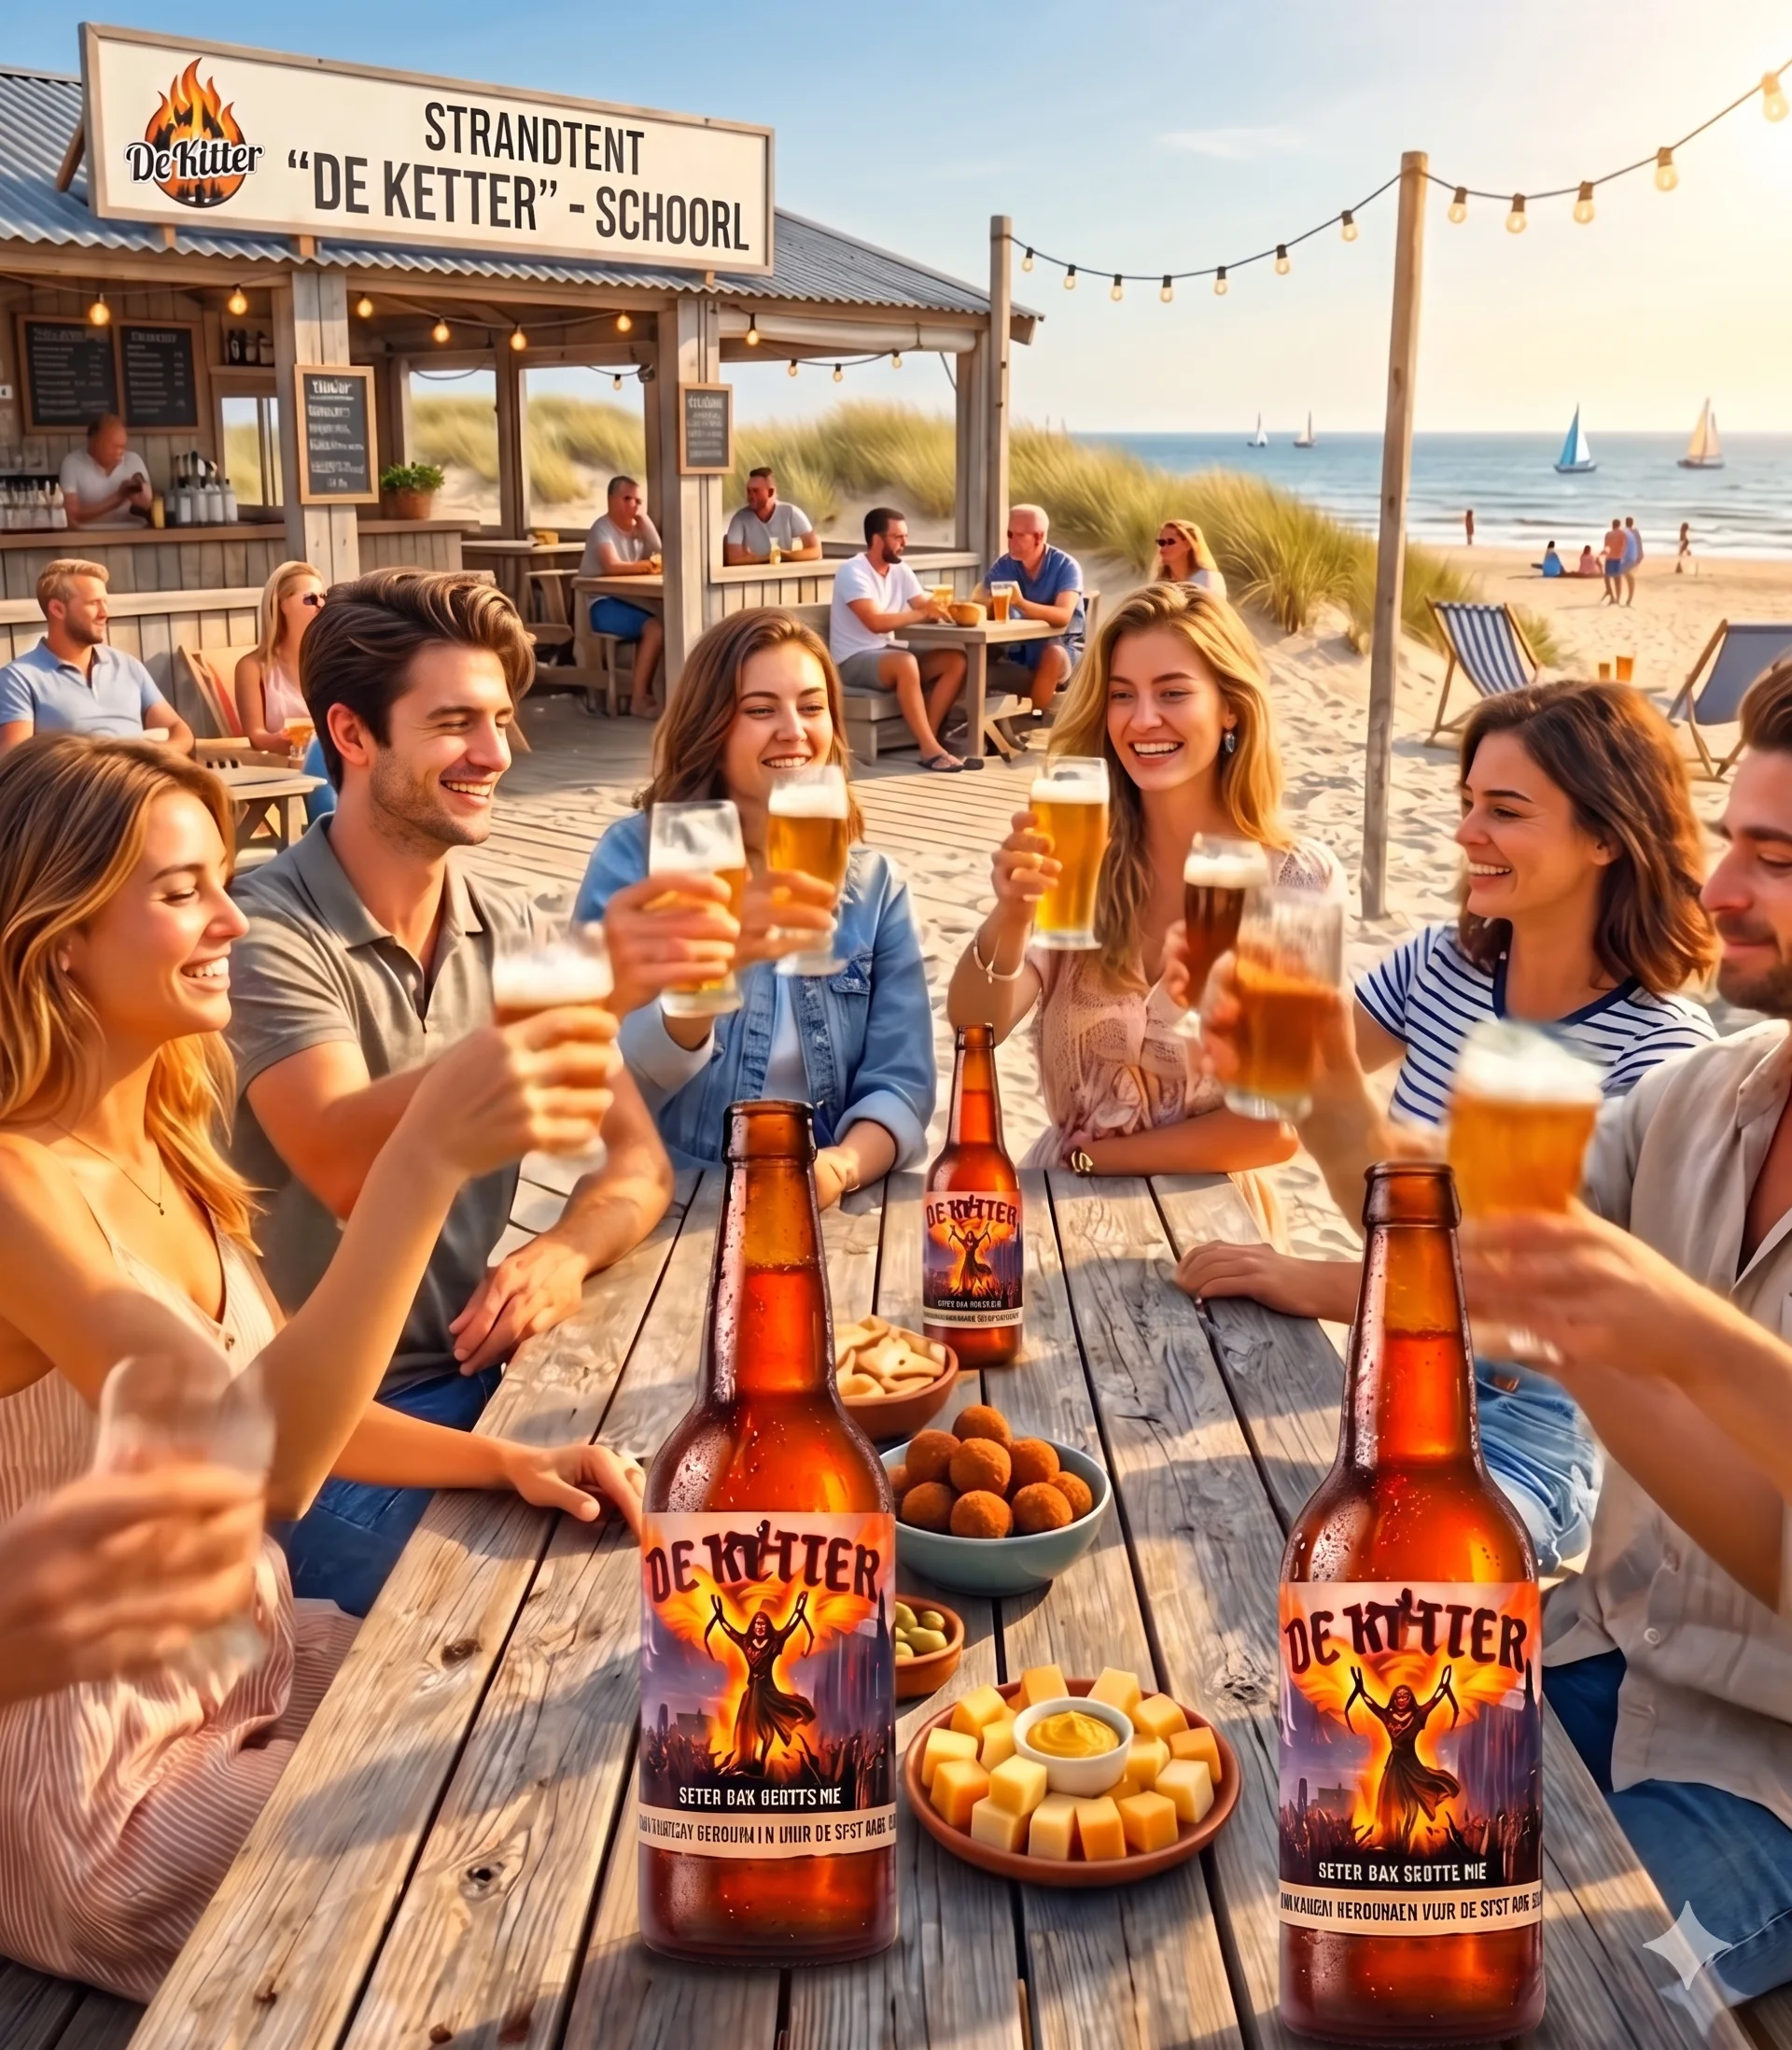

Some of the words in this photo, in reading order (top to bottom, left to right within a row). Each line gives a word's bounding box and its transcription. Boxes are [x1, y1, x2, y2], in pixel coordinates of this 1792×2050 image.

[425, 102, 645, 176] STRANDTENT
[172, 137, 263, 177] Kitter
[595, 187, 750, 252] SCHOORL
[926, 1202, 947, 1229] DE
[645, 1539, 700, 1604] DE
[1284, 1609, 1340, 1675] DE
[679, 1787, 721, 1805] SETER
[816, 1824, 832, 1843] DE
[1319, 1861, 1363, 1881] SETER
[1461, 1901, 1477, 1919] DE
